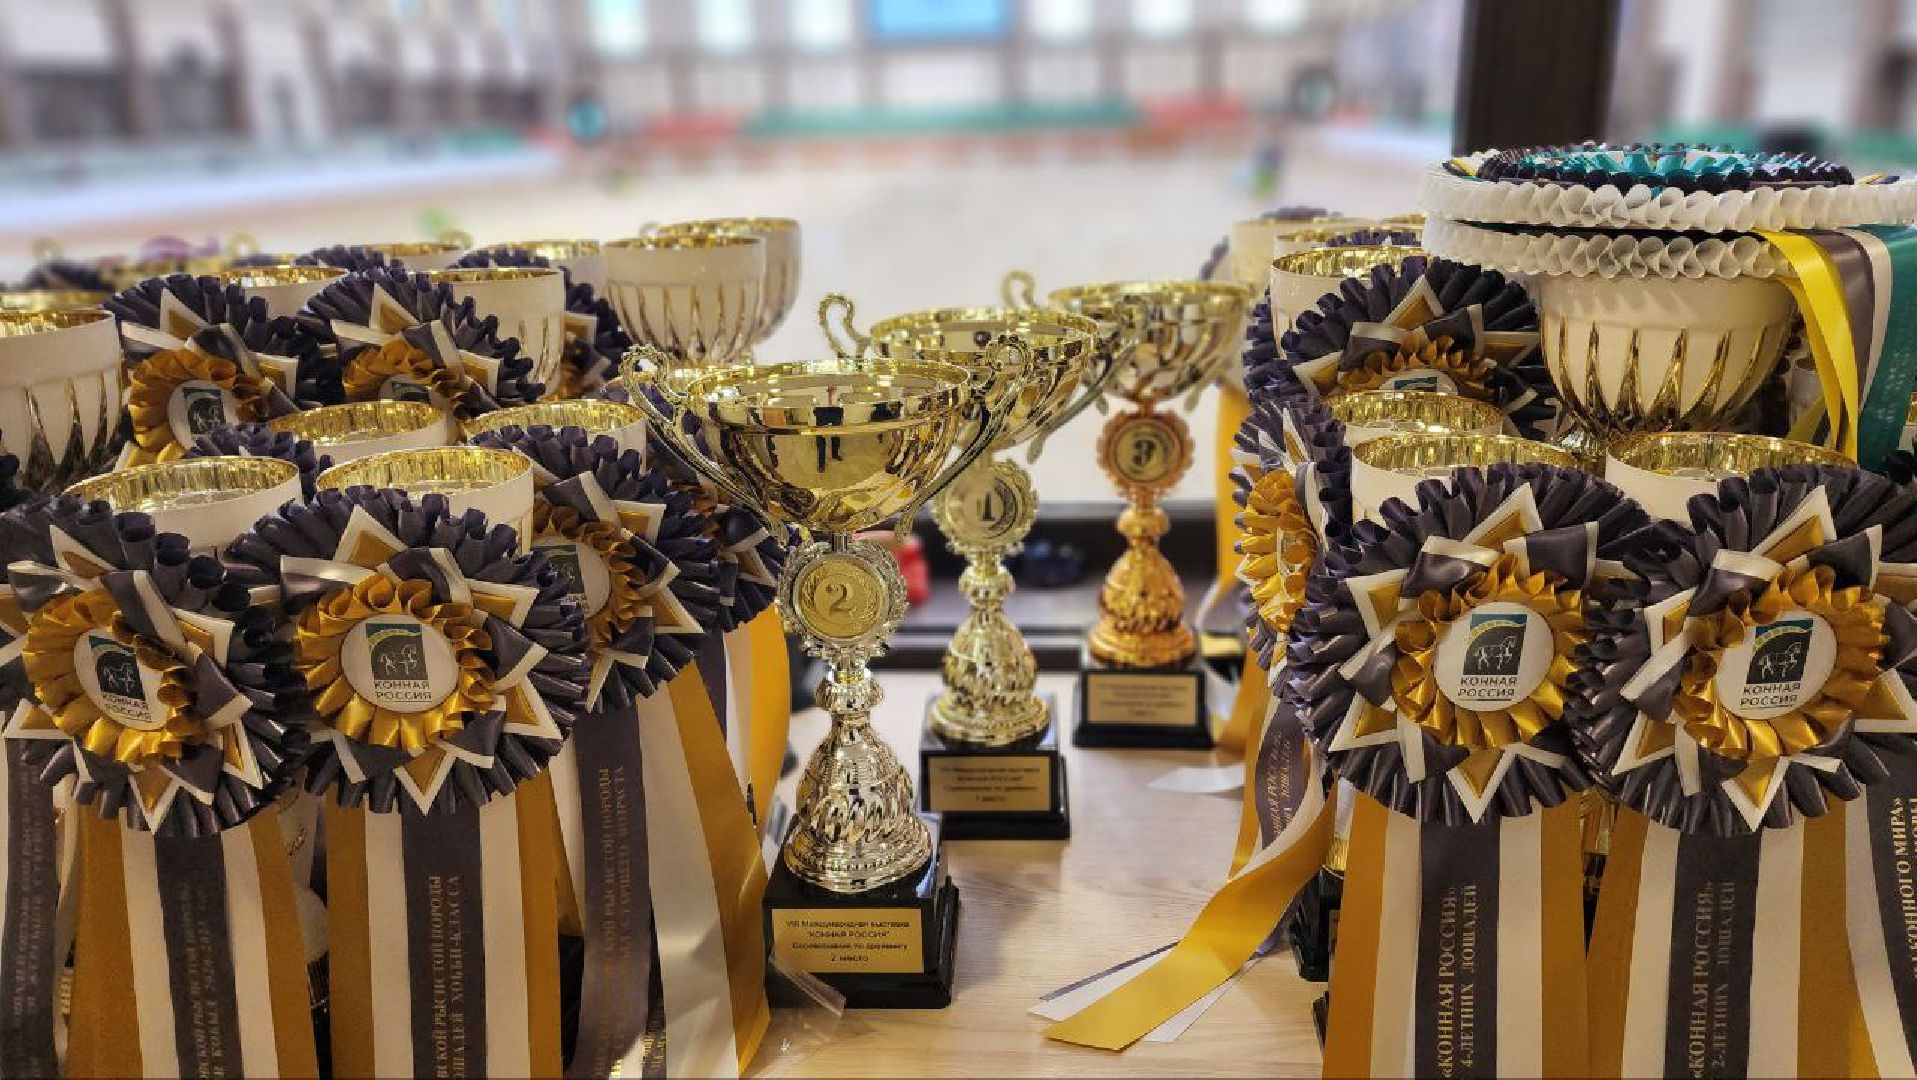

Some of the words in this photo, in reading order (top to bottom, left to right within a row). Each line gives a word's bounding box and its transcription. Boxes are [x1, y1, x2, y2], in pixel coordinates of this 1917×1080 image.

[1133, 438, 1157, 468] 3
[825, 583, 853, 613] 2
[374, 680, 430, 689] КОННАЯ
[1457, 689, 1515, 697] РОССИЯ
[1460, 677, 1518, 686] КОННАЯ
[1743, 683, 1801, 695] КОННАЯ
[102, 694, 149, 710] КОННАЯ
[105, 704, 152, 720] РОССИЯ
[1740, 695, 1798, 706] РОССИЯ
[1891, 797, 1908, 856] МИРА»
[428, 876, 445, 941] ПОРОДЫ
[1461, 885, 1478, 973] ЛОШАДЕЙ
[1436, 984, 1454, 1078] «КОННАЯ
[1460, 984, 1474, 1067] 4-ЛЕТНИХ
[1688, 984, 1709, 1079] «КОННАЯ
[1712, 984, 1728, 1068] 2-ЛЕТНИХ
